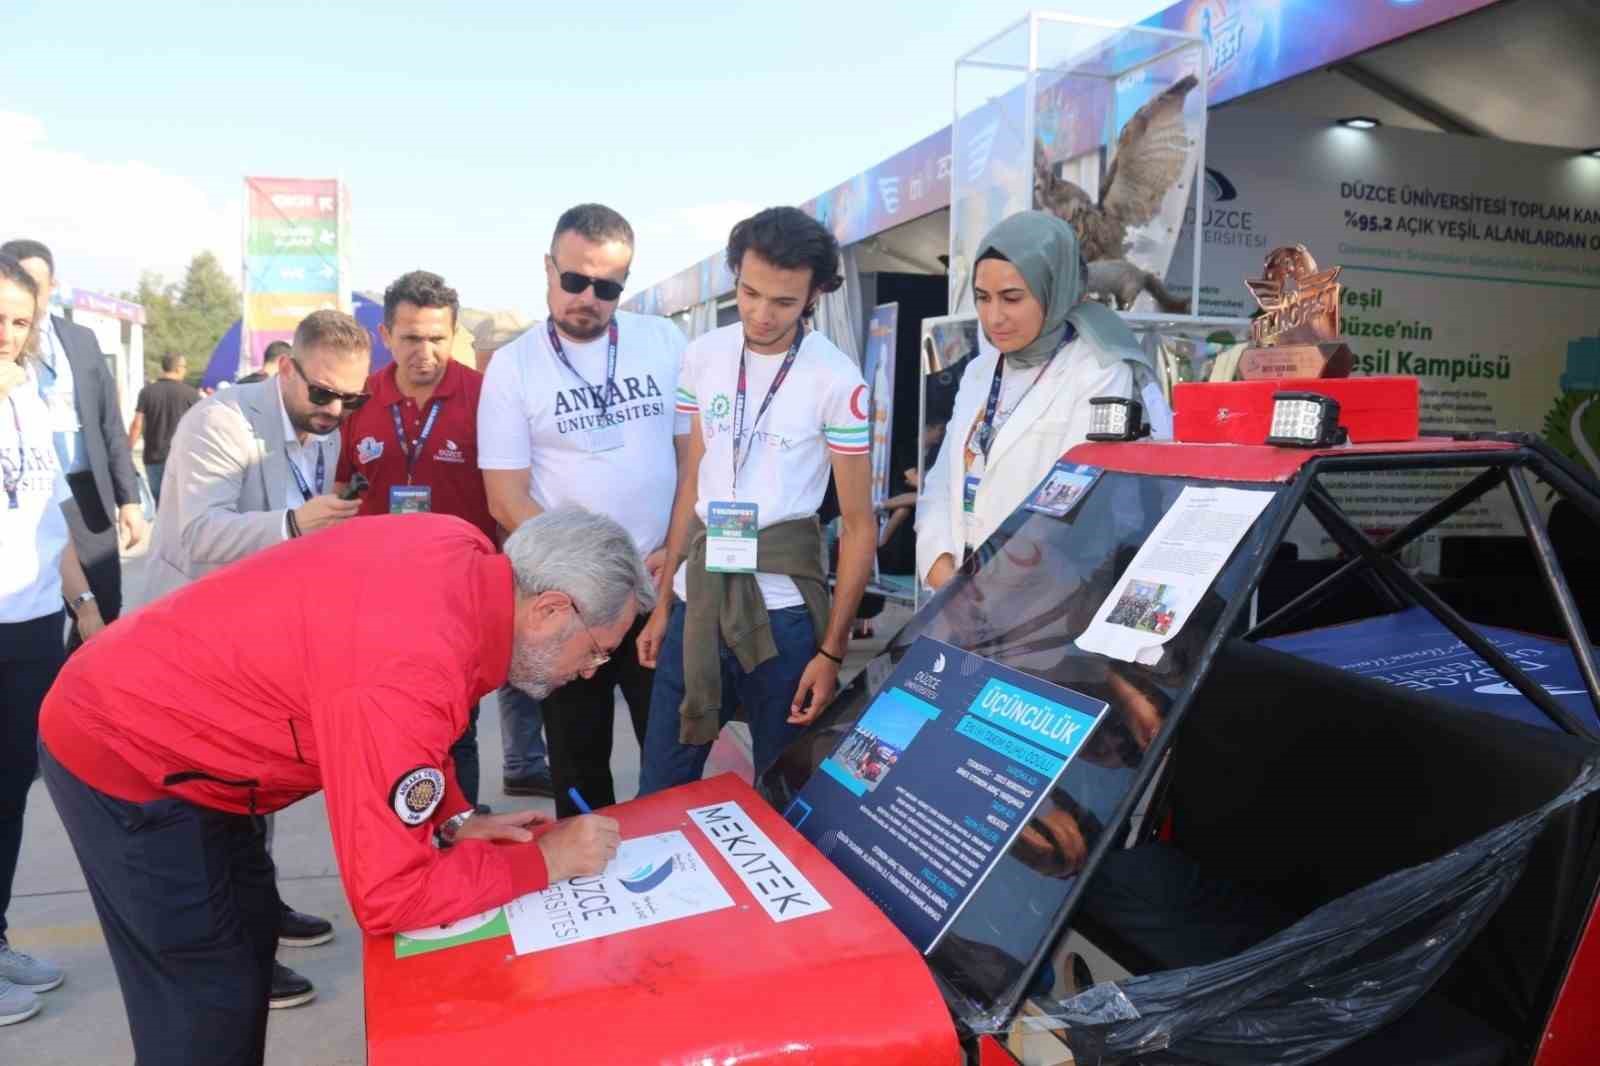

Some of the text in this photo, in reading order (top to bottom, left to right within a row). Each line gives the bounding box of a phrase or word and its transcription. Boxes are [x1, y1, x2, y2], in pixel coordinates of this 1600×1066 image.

[1340, 182, 1396, 204] DÜZCE
[1401, 188, 1506, 217] ÜNİVERSİTESİ
[1511, 201, 1570, 222] TOPLAM
[1396, 215, 1433, 238] AÇIK
[1438, 219, 1481, 241] YEŞİL
[1485, 229, 1586, 249] ALANLARDAN
[1351, 349, 1511, 382] eşil Kampüsü
[554, 373, 663, 416] ANKARA
[981, 685, 1081, 745] ÜÇÜNCÜLÜK
[698, 804, 811, 914] MEKATEK
[568, 871, 617, 923] ÜZCE
